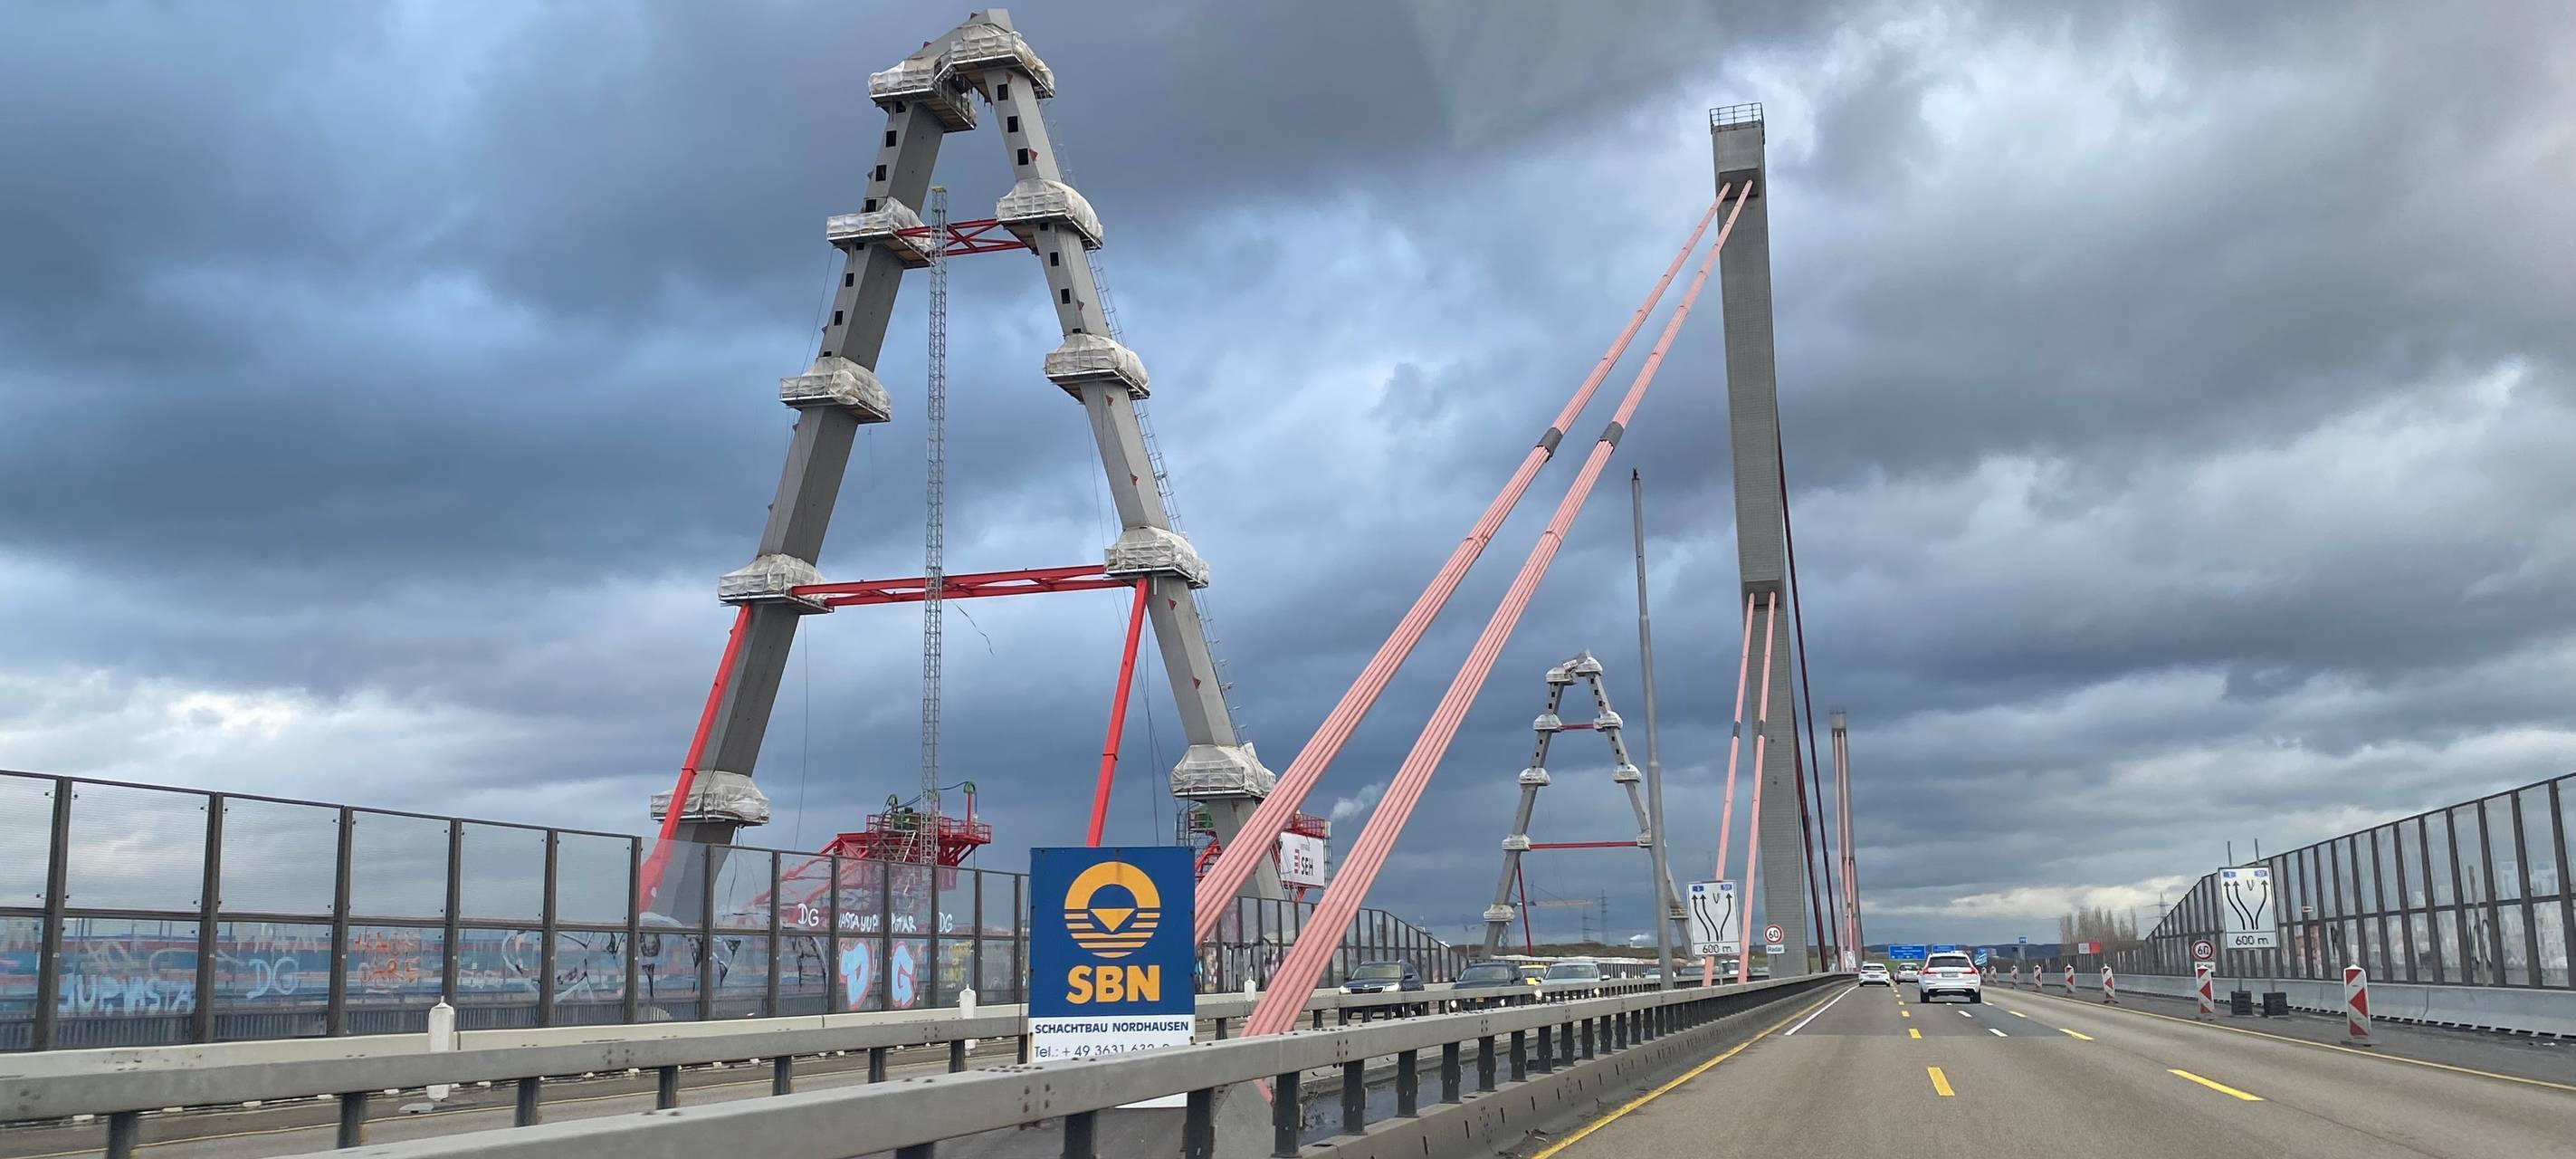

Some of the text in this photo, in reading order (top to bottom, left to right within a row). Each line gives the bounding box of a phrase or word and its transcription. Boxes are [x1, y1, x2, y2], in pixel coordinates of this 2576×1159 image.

[797, 903, 819, 927] DG
[1768, 930, 1779, 939] 60
[2236, 935, 2268, 945] 600 m
[1703, 944, 1720, 953] 600
[2197, 946, 2209, 955] 60
[1065, 964, 1160, 1005] SBN
[1035, 1021, 1188, 1034] SCHACHTBAU NORDHAUSEN
[1074, 1045, 1090, 1057] 49
